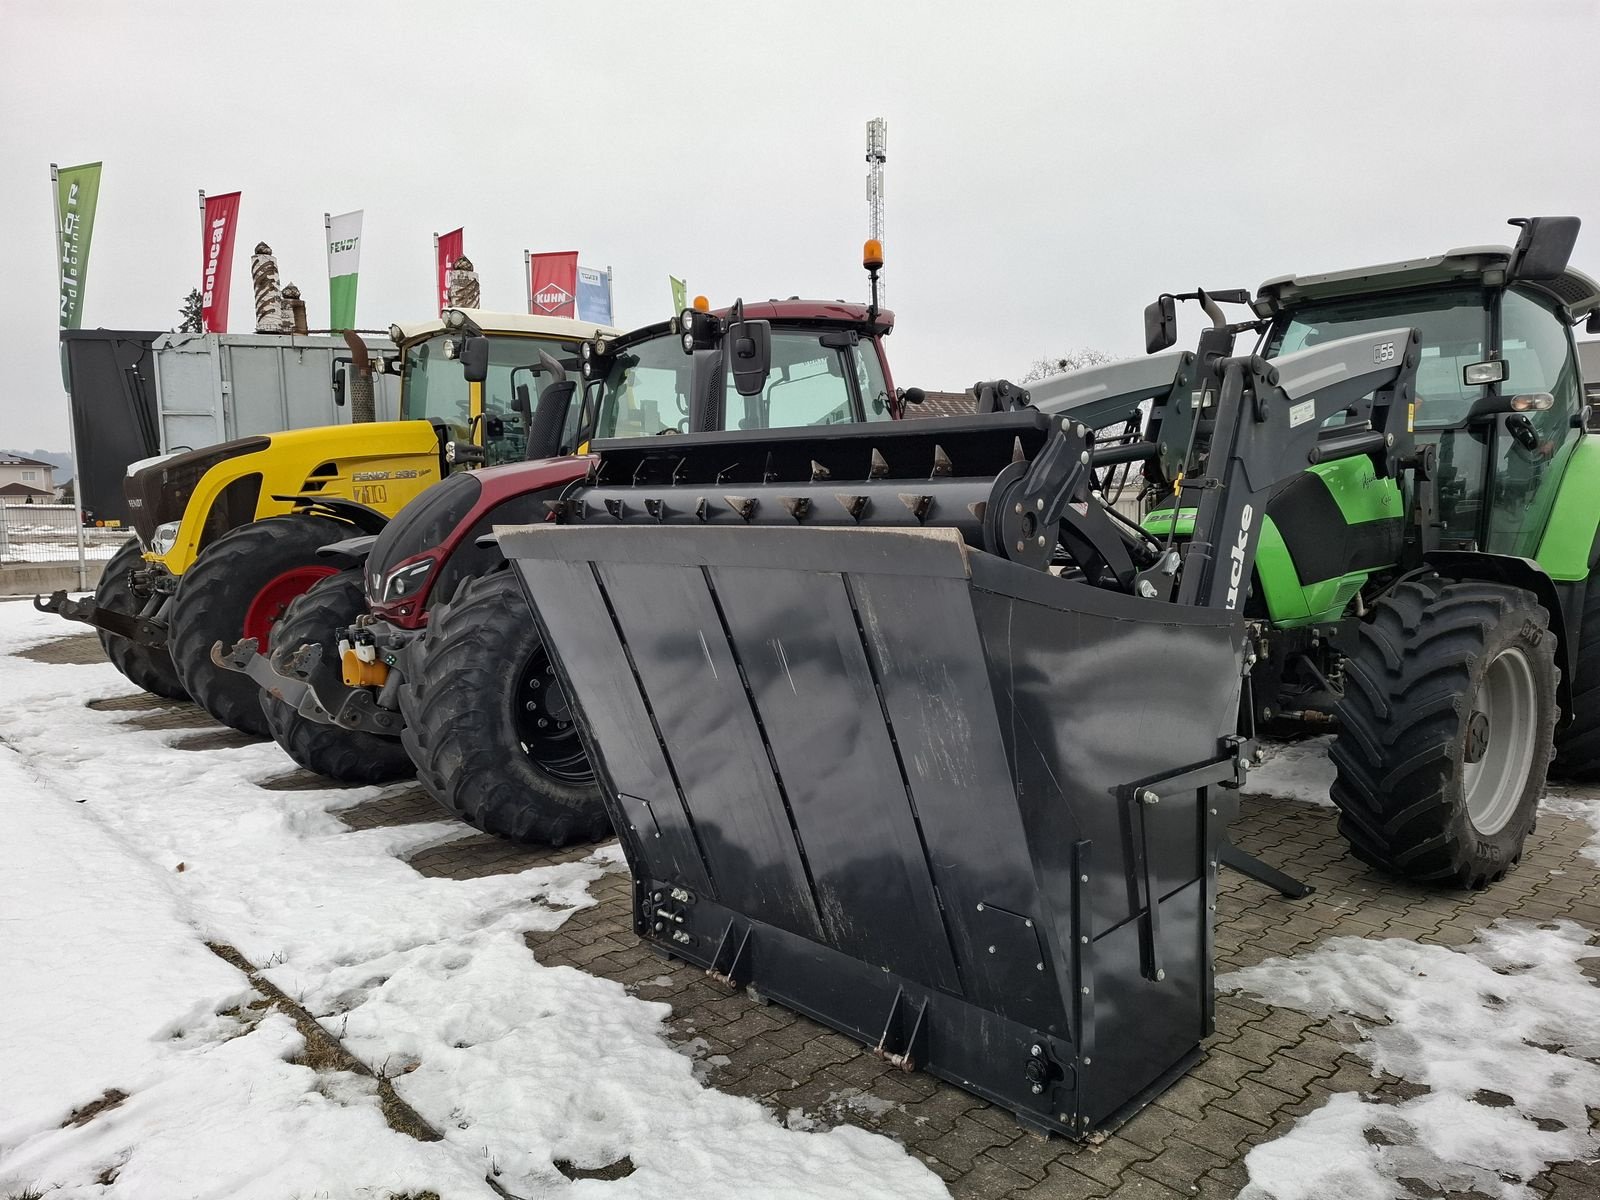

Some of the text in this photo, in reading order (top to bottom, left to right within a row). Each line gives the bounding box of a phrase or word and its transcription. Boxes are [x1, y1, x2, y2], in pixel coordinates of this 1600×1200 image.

[330, 237, 359, 254] FENDT
[202, 217, 226, 308] Bobcat
[536, 293, 566, 304] KUHN
